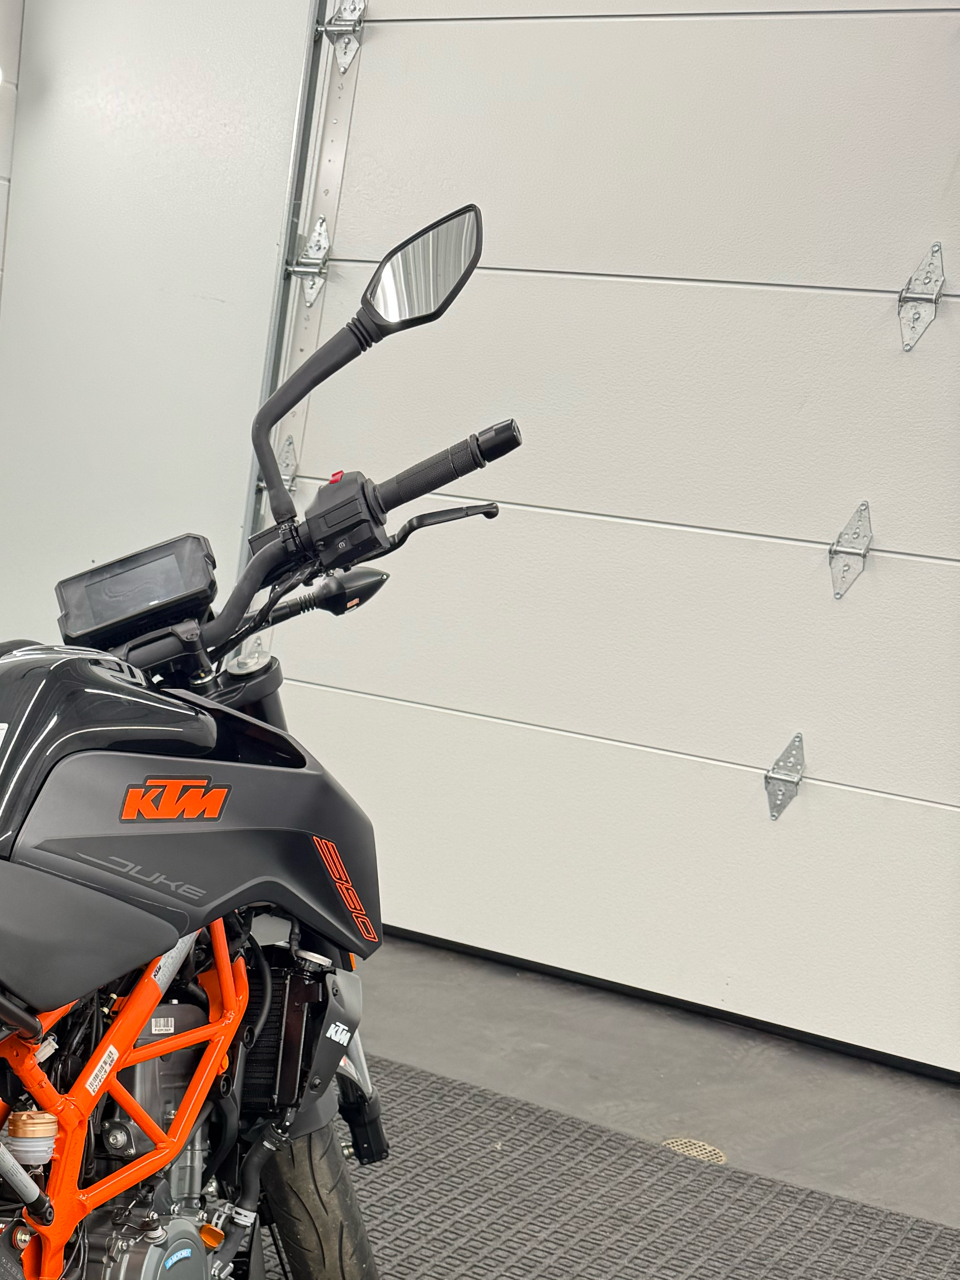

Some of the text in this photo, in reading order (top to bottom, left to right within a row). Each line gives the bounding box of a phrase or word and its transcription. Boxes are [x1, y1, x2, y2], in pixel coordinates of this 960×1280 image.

[121, 779, 228, 819] KTM
[76, 852, 207, 900] DUKE
[312, 835, 379, 942] 390
[325, 1021, 351, 1047] KTM
